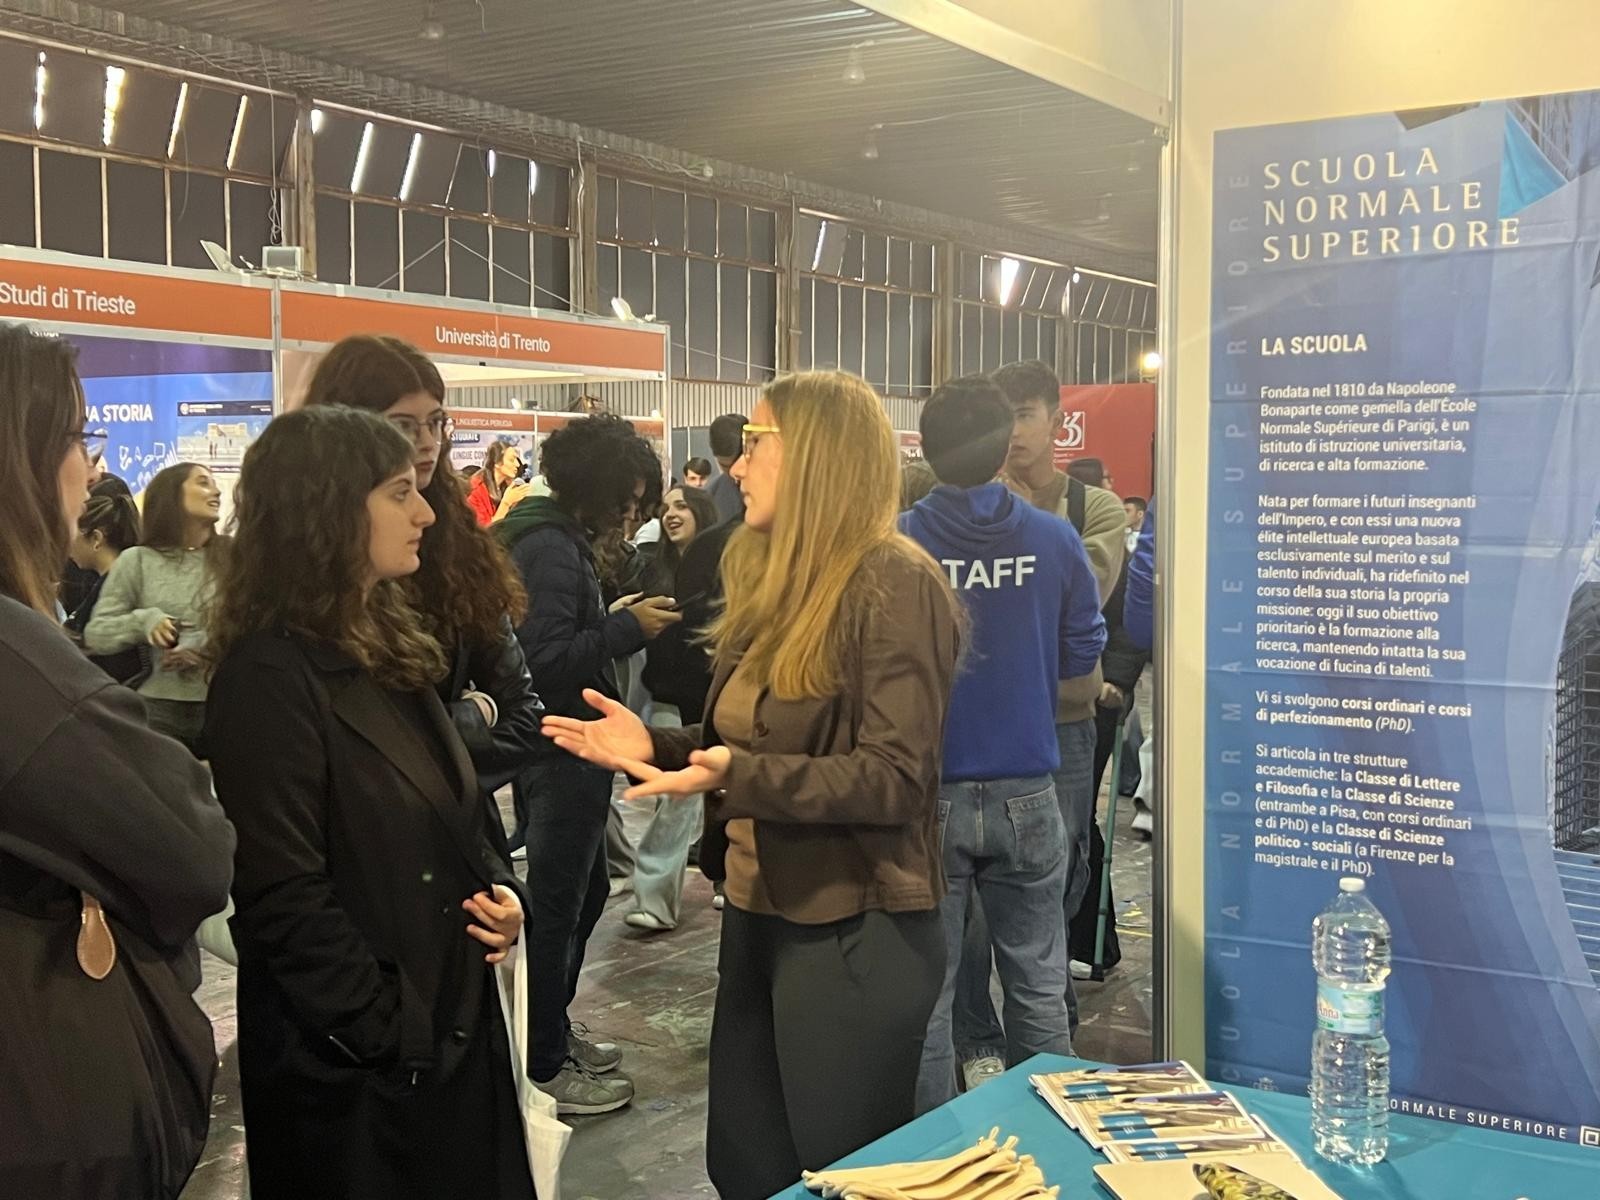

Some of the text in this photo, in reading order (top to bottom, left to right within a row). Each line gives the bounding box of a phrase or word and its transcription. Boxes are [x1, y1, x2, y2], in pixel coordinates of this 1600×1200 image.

[1263, 147, 1439, 189] SCUOLA
[1264, 182, 1481, 226] NORMALE
[1263, 218, 1520, 262] SUPERIORE
[0, 283, 136, 315] Studi di Trieste
[436, 326, 550, 352] Università di Trento
[1224, 174, 1249, 524] SUPERIORE
[1261, 334, 1368, 355] LA SCUOLA
[1261, 381, 1456, 398] Fondata nel 1810 da Napoleone
[103, 404, 153, 422] STORIA
[1261, 403, 1322, 418] Bonaparte
[1325, 405, 1359, 415] come
[1362, 401, 1412, 417] gemella
[1260, 419, 1469, 435] Normale Supérieure di Parigi, è un
[1259, 437, 1466, 453] istituto di istruzione universitaria,
[1259, 457, 1429, 471] di ricerca e alta formazione.
[1258, 494, 1476, 511] Nata per formare i futuri insegnanti
[1330, 517, 1337, 526] e
[1341, 517, 1363, 526] con
[1366, 514, 1391, 526] essi
[1395, 517, 1417, 527] una
[1421, 518, 1460, 527] nuova
[1258, 531, 1459, 547] élite intellettuale europea basata
[1257, 549, 1450, 565] esclusivamente sul merito e sul
[941, 555, 1036, 589] TAFF
[1258, 567, 1469, 584] talento individuali, ha ridefinito nel
[1257, 586, 1448, 605] corso della sua storia la propria
[1257, 603, 1438, 621] missione: oggi il suo obiettivo
[1257, 620, 1439, 640] prioritario è la formazione alla
[1256, 638, 1466, 660] ricerca, mantenendo intatta la sua
[1256, 657, 1433, 677] vocazione di fucina di talenti.
[1221, 579, 1243, 849] NORMALE
[1256, 690, 1472, 717] Vi si svolgono corsi ordinari e corsi
[1256, 708, 1415, 734] di perfezionamento (PhD).
[1256, 744, 1407, 768] Si articola in tre strutture
[1256, 762, 1460, 792] accademiche: la Classe di Lettere
[1256, 781, 1454, 810] e Filosofia e la Classe di Scienze
[1255, 797, 1472, 830] (entrambe a Pisa, con corsi ordinari
[1255, 816, 1444, 846] e di PhD) e la Classe di Scienze
[1255, 834, 1300, 848] politico
[1312, 839, 1352, 854] sociali
[1355, 843, 1367, 858] (a
[1370, 845, 1415, 861] Firenze
[1419, 850, 1439, 865] per
[1442, 852, 1454, 865] la
[1255, 852, 1374, 876] magistrale e il PhD).
[1388, 1098, 1568, 1139] ORMALE SUPERIORE
